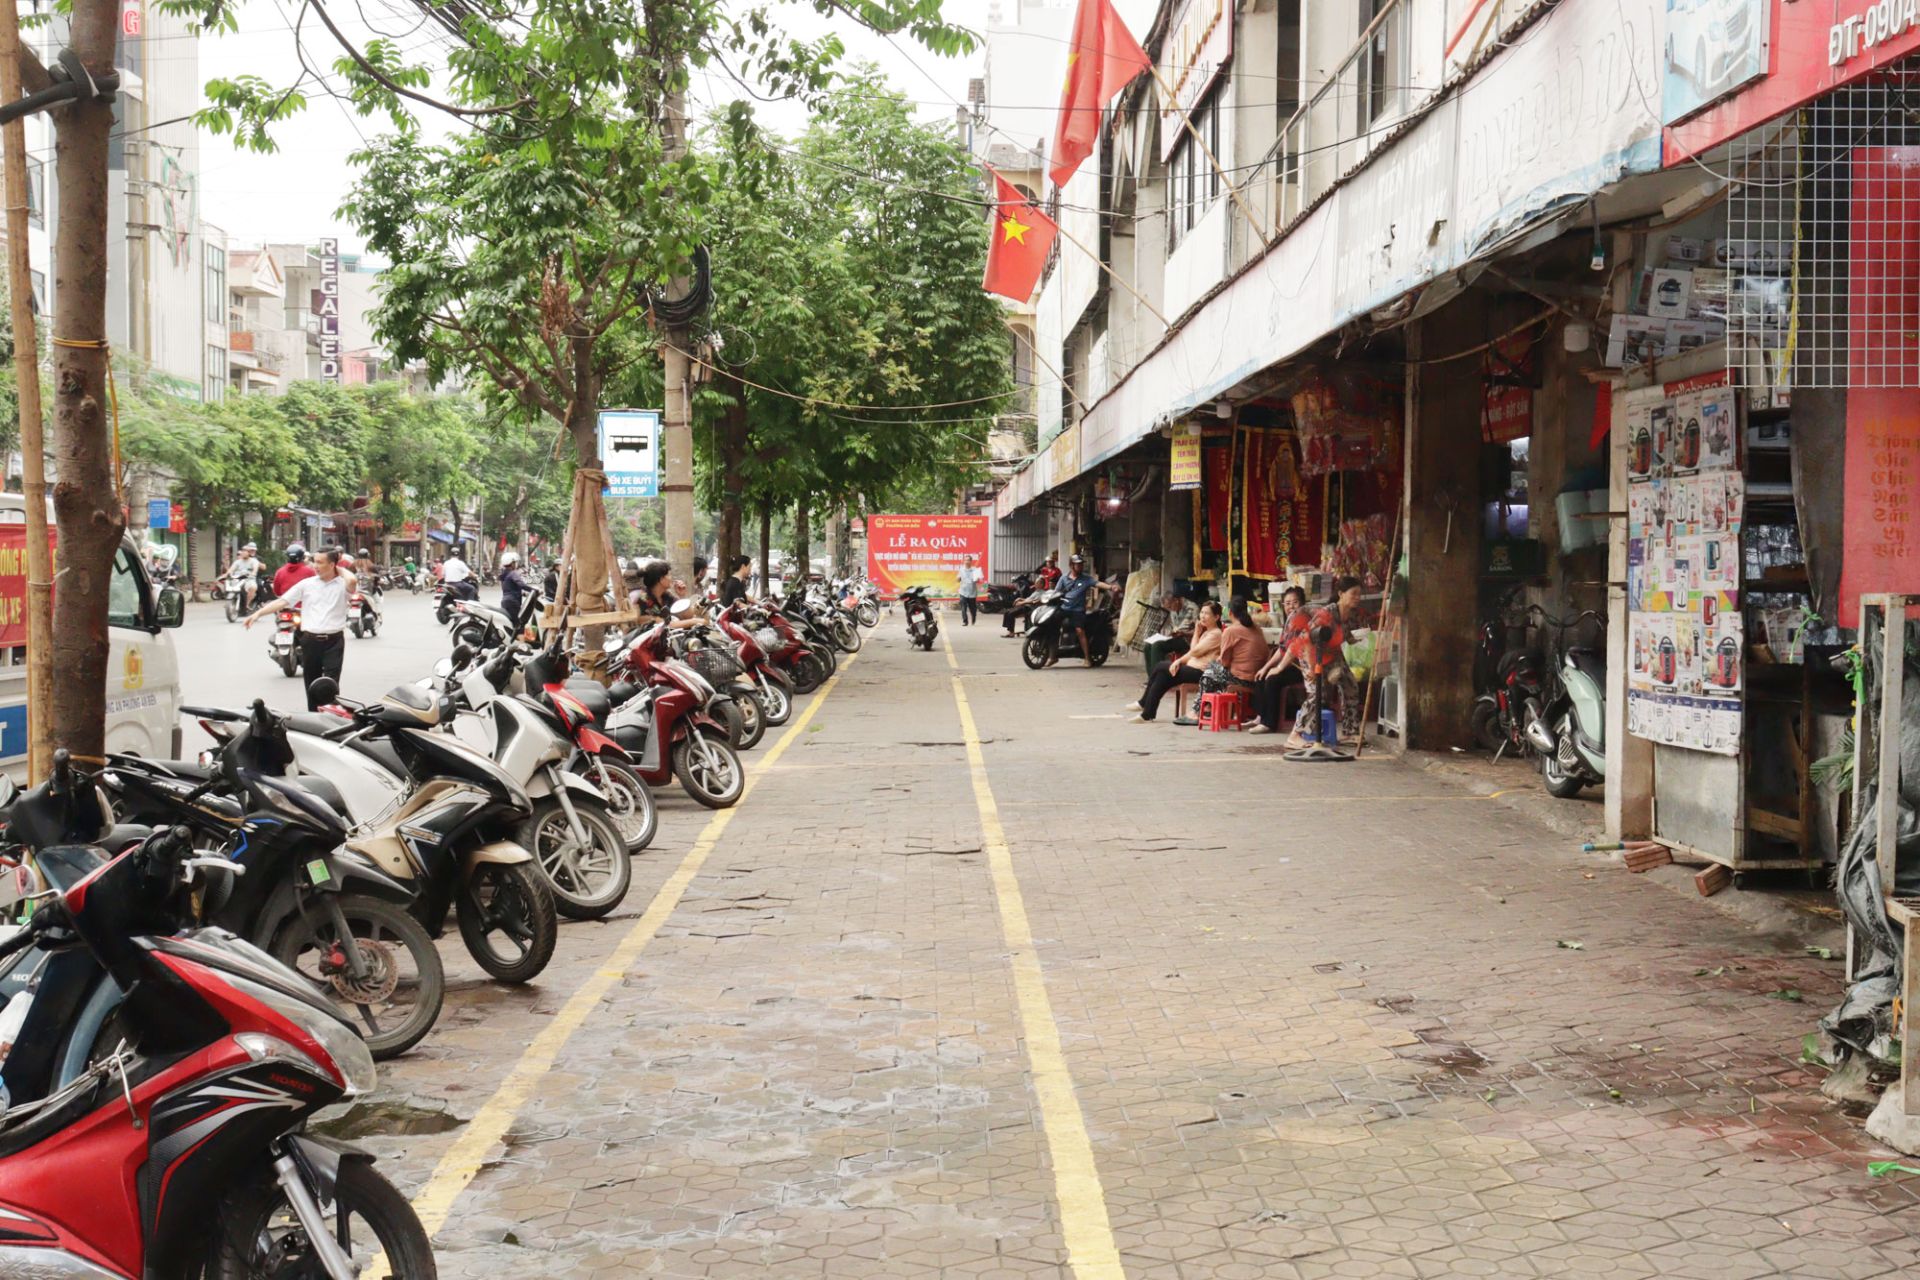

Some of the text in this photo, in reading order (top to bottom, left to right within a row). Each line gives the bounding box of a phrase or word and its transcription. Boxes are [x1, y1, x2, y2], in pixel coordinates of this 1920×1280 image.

[611, 486, 647, 495] BUS STOP
[889, 532, 967, 549] LỄ RA QUÂN
